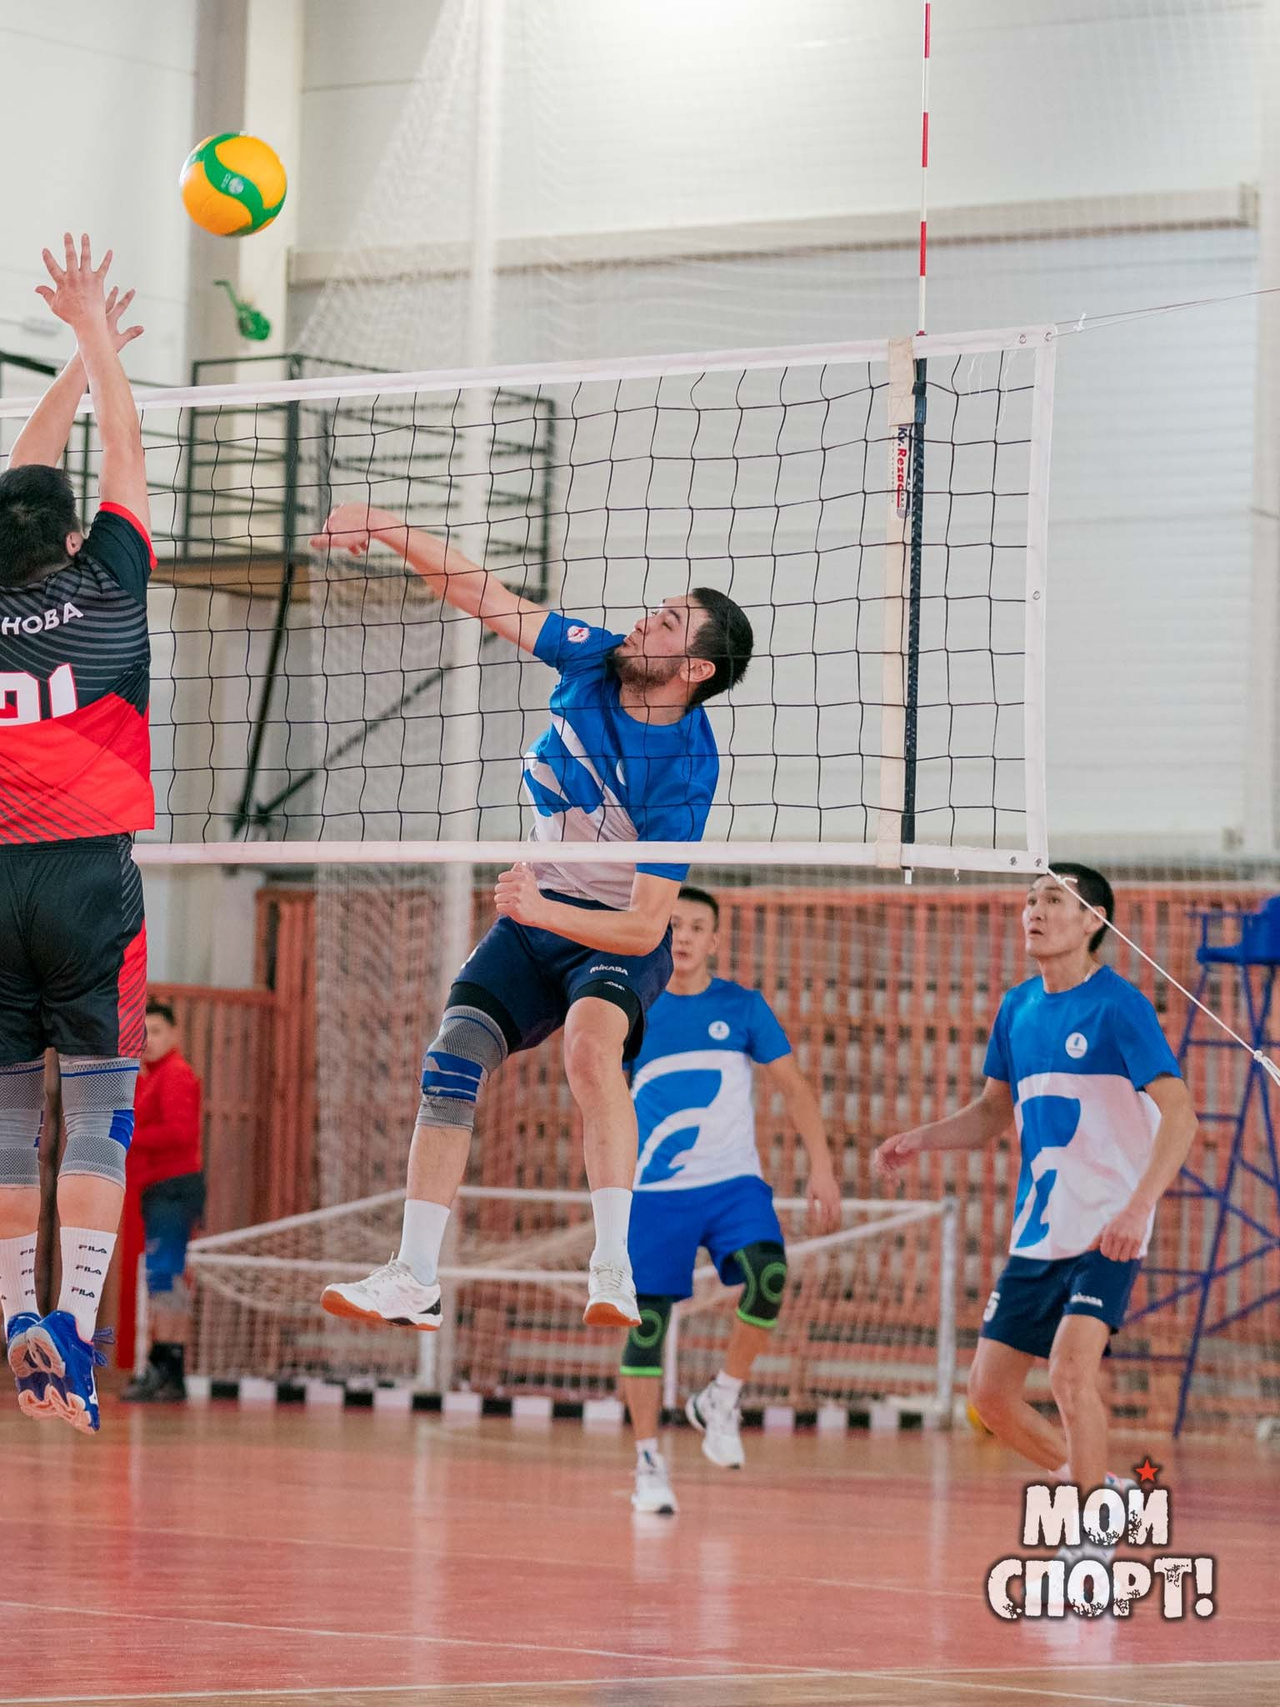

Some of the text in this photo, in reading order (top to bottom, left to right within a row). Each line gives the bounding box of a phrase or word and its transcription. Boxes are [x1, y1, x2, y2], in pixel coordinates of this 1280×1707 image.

[78, 1244, 107, 1254] FILA
[75, 1264, 102, 1275] FILA
[71, 1286, 95, 1298] FILA
